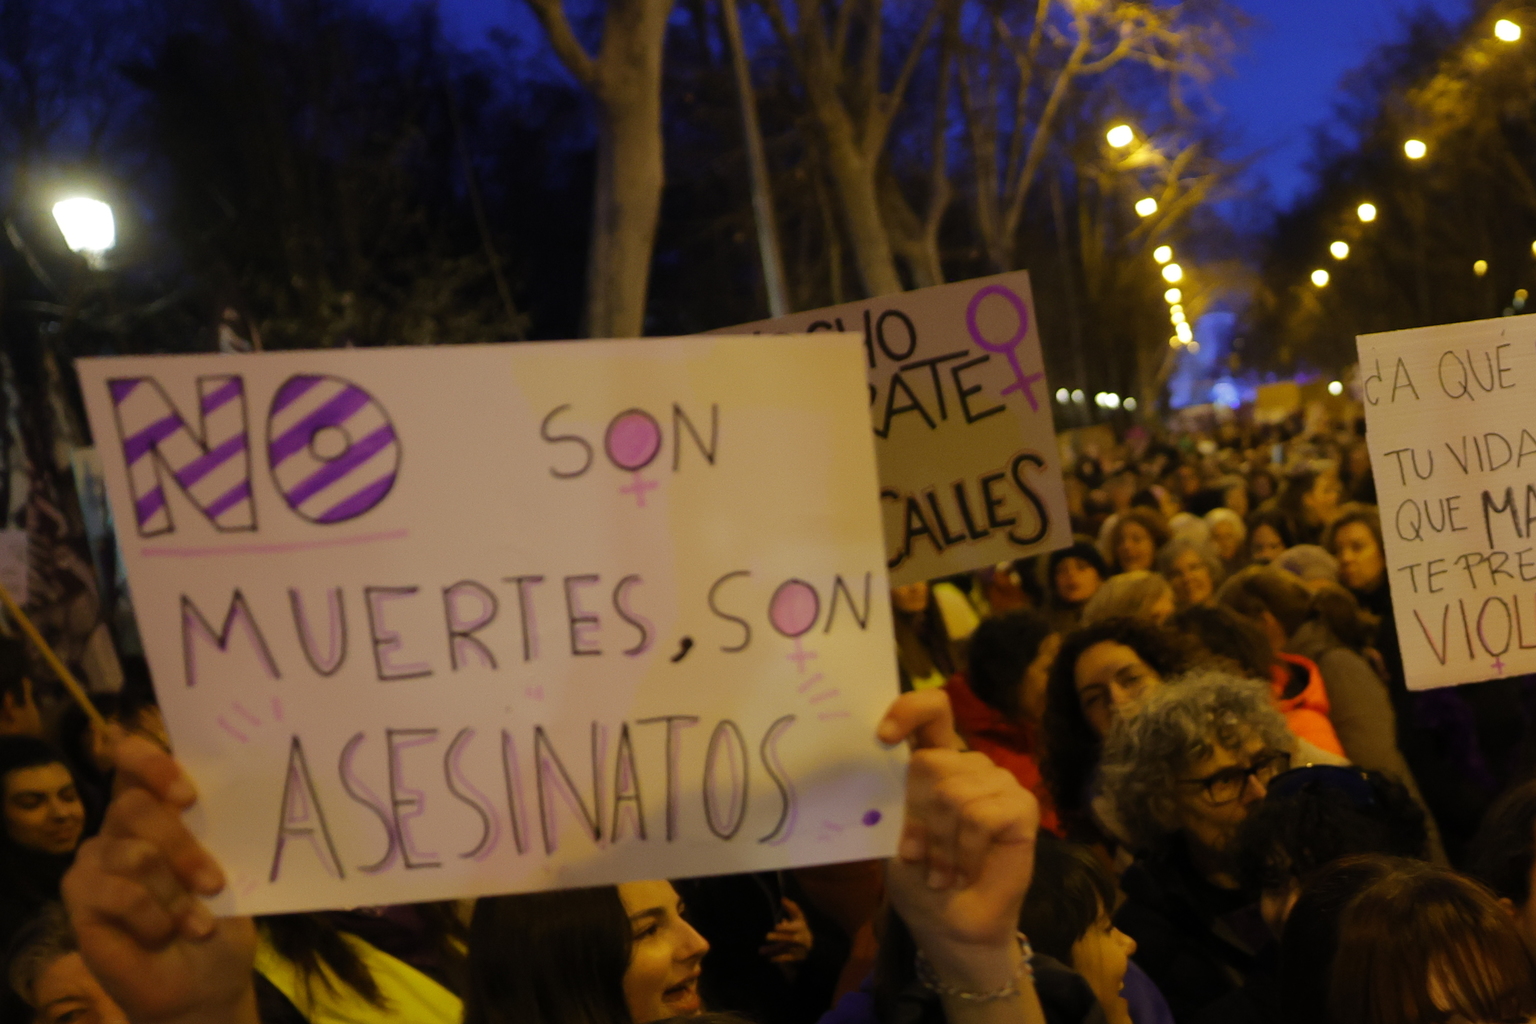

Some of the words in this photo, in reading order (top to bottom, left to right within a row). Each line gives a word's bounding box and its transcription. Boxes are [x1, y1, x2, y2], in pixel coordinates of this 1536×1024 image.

[1438, 330, 1516, 401] QUÉ
[107, 373, 402, 538] NO
[540, 402, 718, 480] SON
[1384, 448, 1433, 486] TU
[1395, 496, 1468, 542] QUE
[1398, 558, 1447, 593] TE
[180, 573, 694, 687] MUERTES,
[707, 570, 872, 653] SON
